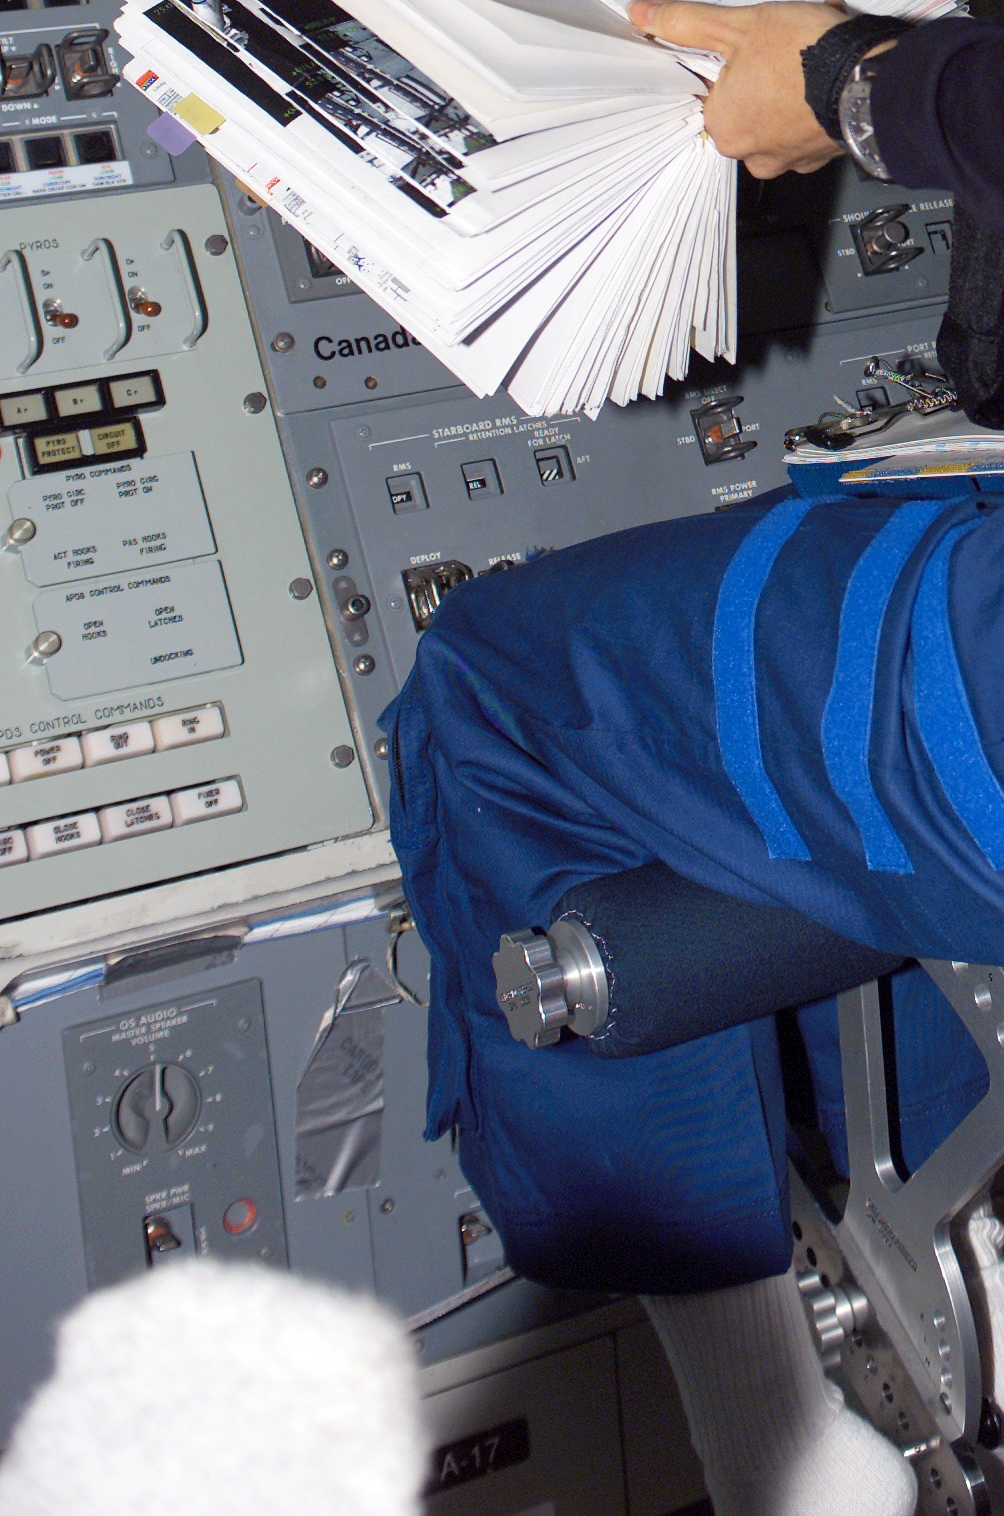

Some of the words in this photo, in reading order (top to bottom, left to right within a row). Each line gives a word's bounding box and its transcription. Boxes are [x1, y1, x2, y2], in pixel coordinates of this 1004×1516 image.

[2, 103, 31, 111] DOWN
[32, 115, 57, 124] MODE
[19, 239, 60, 252] PYROS
[432, 421, 492, 439] STARBOARD
[496, 416, 517, 427] RMS
[468, 426, 512, 441] RETENTION
[514, 420, 548, 434] LATCHES
[534, 427, 559, 438] READY
[98, 429, 125, 441] CIRCUIT
[528, 438, 544, 447] FOR
[546, 434, 571, 445] LATCH
[677, 435, 695, 446] STBD
[46, 438, 66, 447] PYRO
[106, 440, 121, 449] OFF
[41, 446, 76, 458] PROTECT
[576, 455, 590, 464] AFT
[65, 472, 86, 482] PYRO
[90, 465, 132, 479] COMMANDS
[393, 462, 412, 472] RMS
[116, 480, 136, 490] PYRO
[140, 475, 159, 485] CIRC
[469, 481, 481, 489] REL
[711, 486, 729, 496] RMS
[730, 480, 758, 493] POWER
[42, 493, 63, 503] PYRO
[66, 488, 86, 498] CIRC
[118, 489, 138, 499] PROT
[143, 486, 153, 494] ON
[720, 490, 753, 503] PRIMARY
[45, 501, 65, 512] PROT
[70, 498, 85, 507] OFF
[142, 532, 167, 544] HOOKS
[53, 551, 67, 561] ACT
[72, 545, 98, 557] HOOKS
[139, 544, 167, 556] FIRING
[67, 558, 95, 570] FIRING
[410, 551, 442, 565] DEPLOY
[89, 585, 124, 597] CONTROL
[128, 575, 171, 590] COMMANDS
[154, 605, 175, 616] OPEN
[83, 620, 104, 631] OPEN
[148, 615, 184, 629] LATCHES
[82, 630, 107, 642] HOOKS
[150, 649, 194, 665] UNDOCKING
[30, 714, 87, 734] CONTROL
[94, 696, 165, 720] COMMANDS
[181, 716, 200, 727] RING
[187, 725, 197, 734] IN
[34, 745, 61, 758] POWER
[113, 740, 129, 750] OUT
[42, 755, 57, 766] OFF
[204, 798, 219, 809] OFF
[125, 804, 151, 817] CLOSE
[124, 812, 161, 828] LATCHES
[53, 822, 79, 835] CLOSE
[56, 832, 81, 844] HOOKS
[120, 1019, 135, 1030] OS
[140, 1008, 177, 1025] AUDIO
[112, 1028, 146, 1042] MASTER
[151, 1015, 188, 1033] SPEAKER
[130, 1030, 170, 1045] VOLUME
[185, 1145, 206, 1157] MAX
[122, 1164, 141, 1175] MIN
[145, 1190, 167, 1204] SPKR
[441, 1436, 500, 1482] A-17
